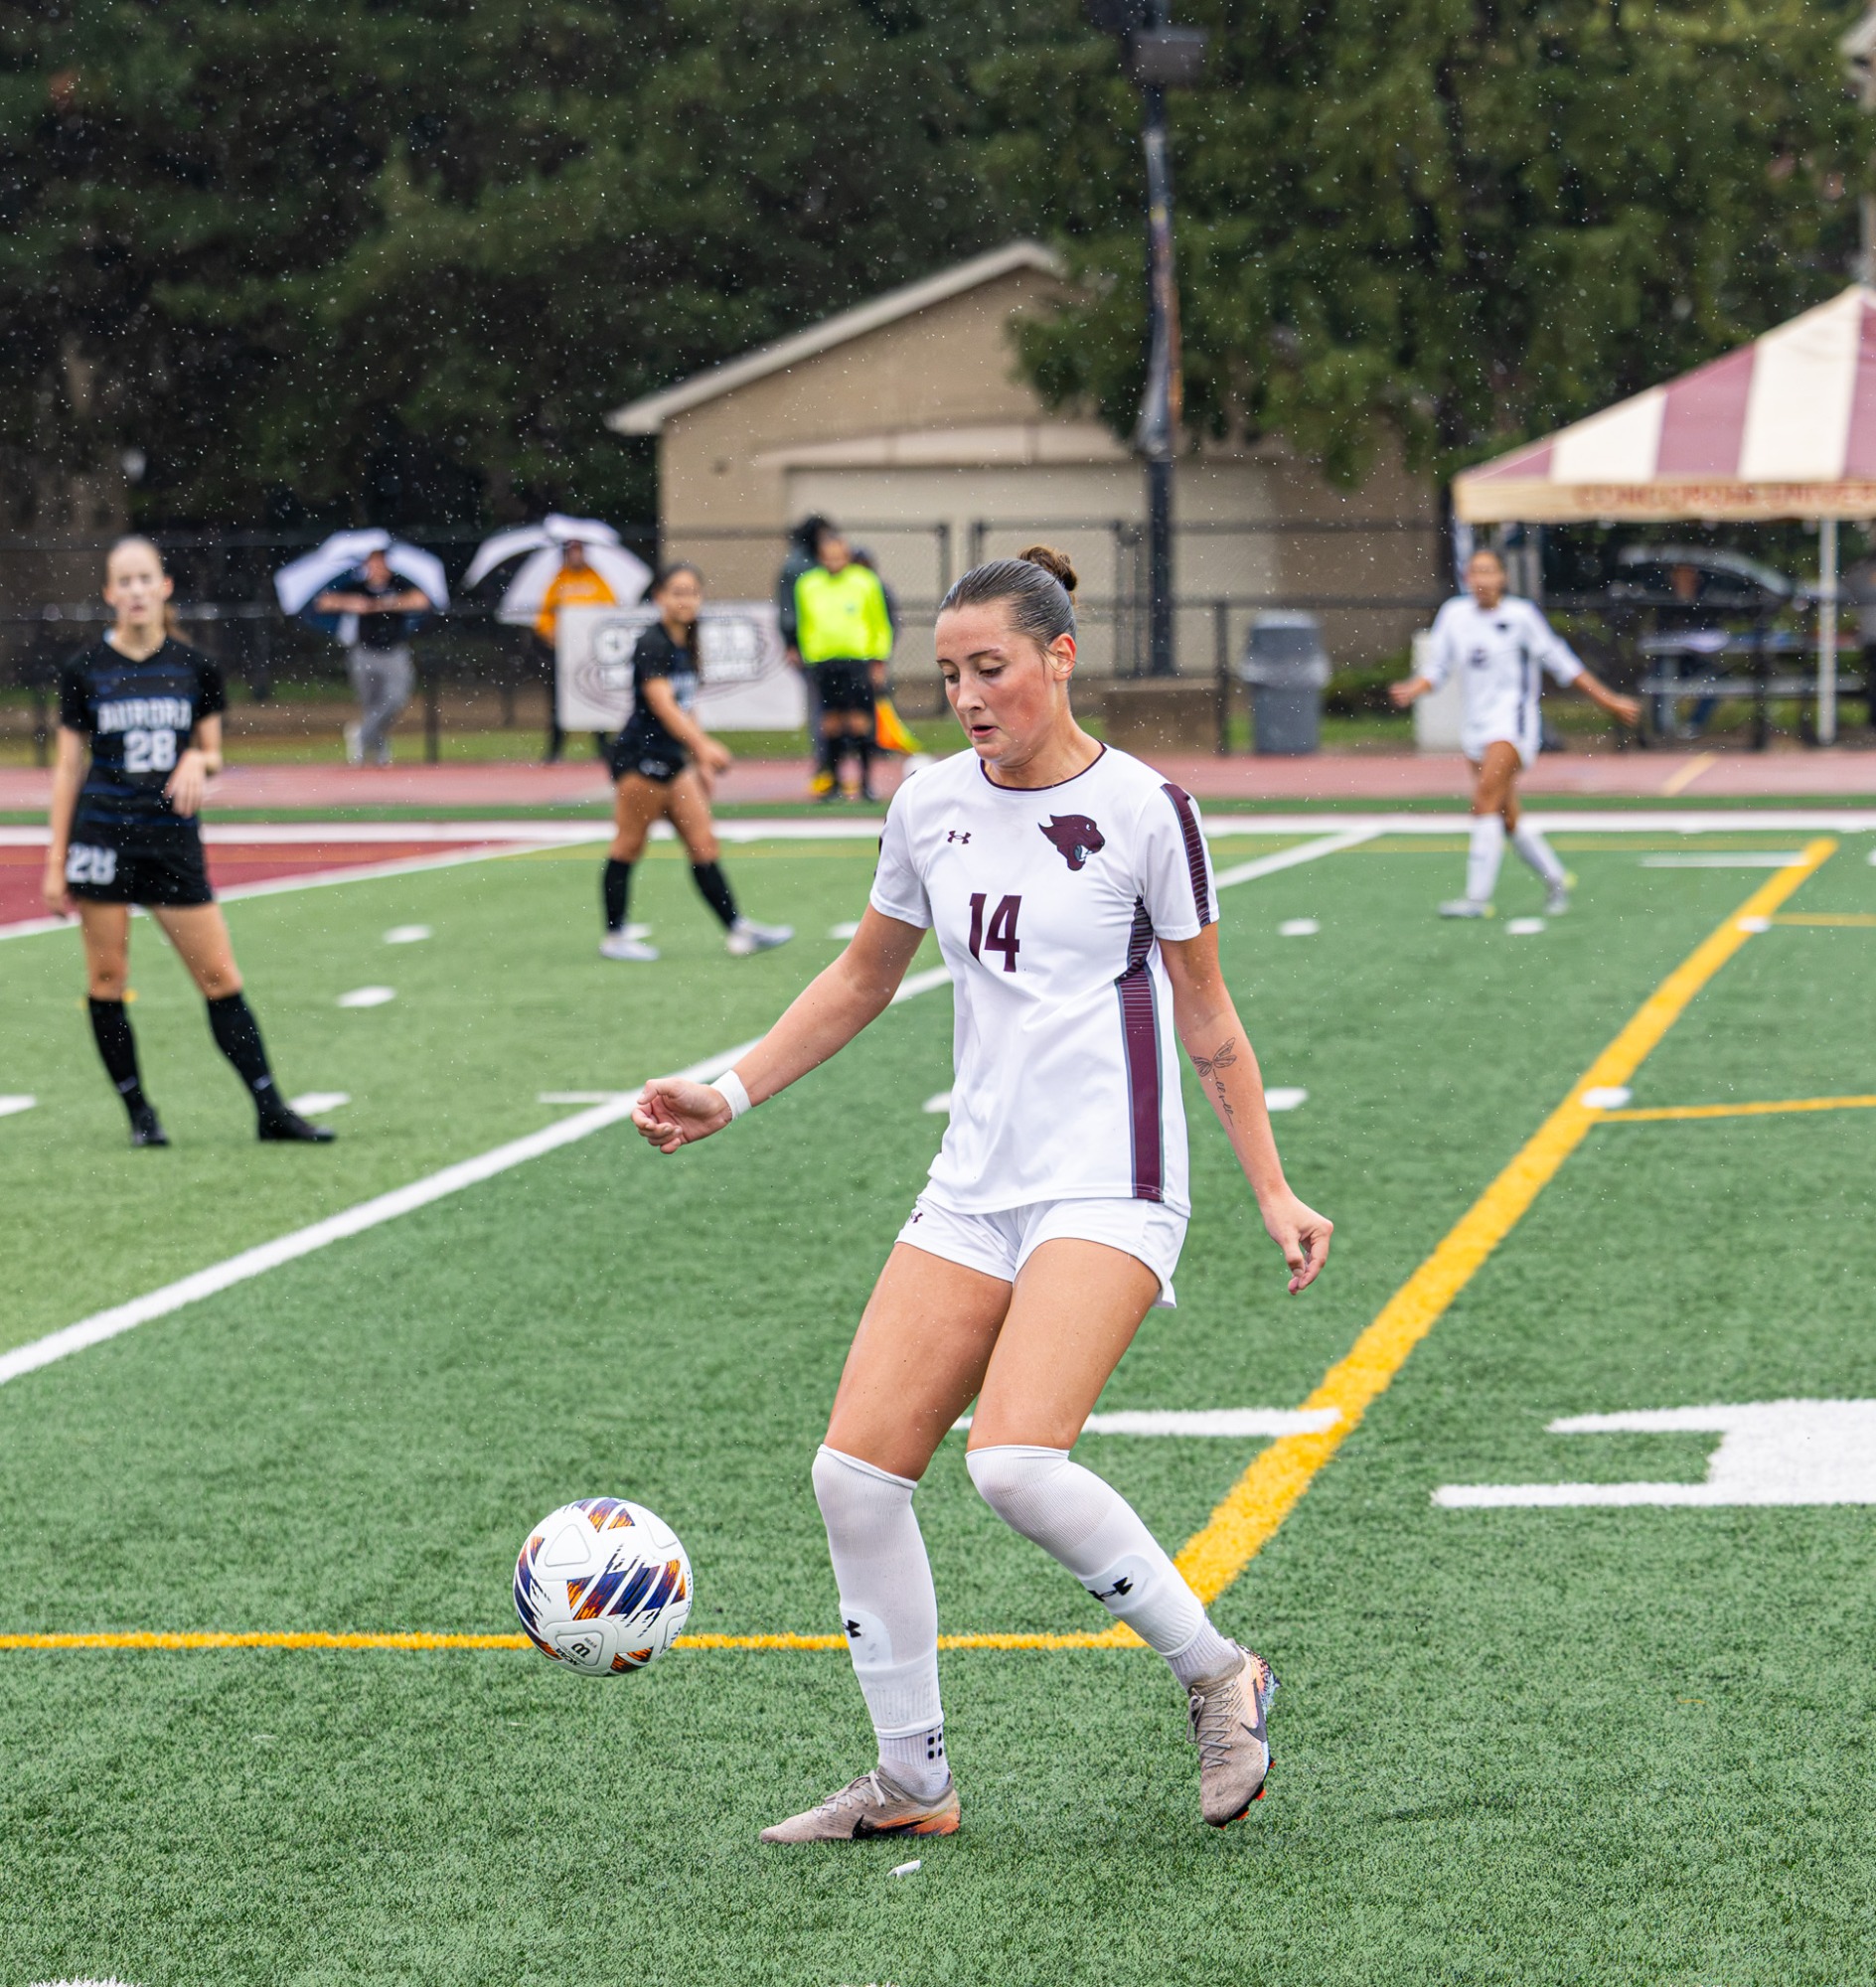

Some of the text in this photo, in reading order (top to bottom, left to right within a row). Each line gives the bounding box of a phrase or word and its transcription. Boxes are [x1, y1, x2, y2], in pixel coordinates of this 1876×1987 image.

[97, 697, 192, 734] AURORA
[122, 729, 177, 773] 28
[969, 892, 1022, 973] 14
